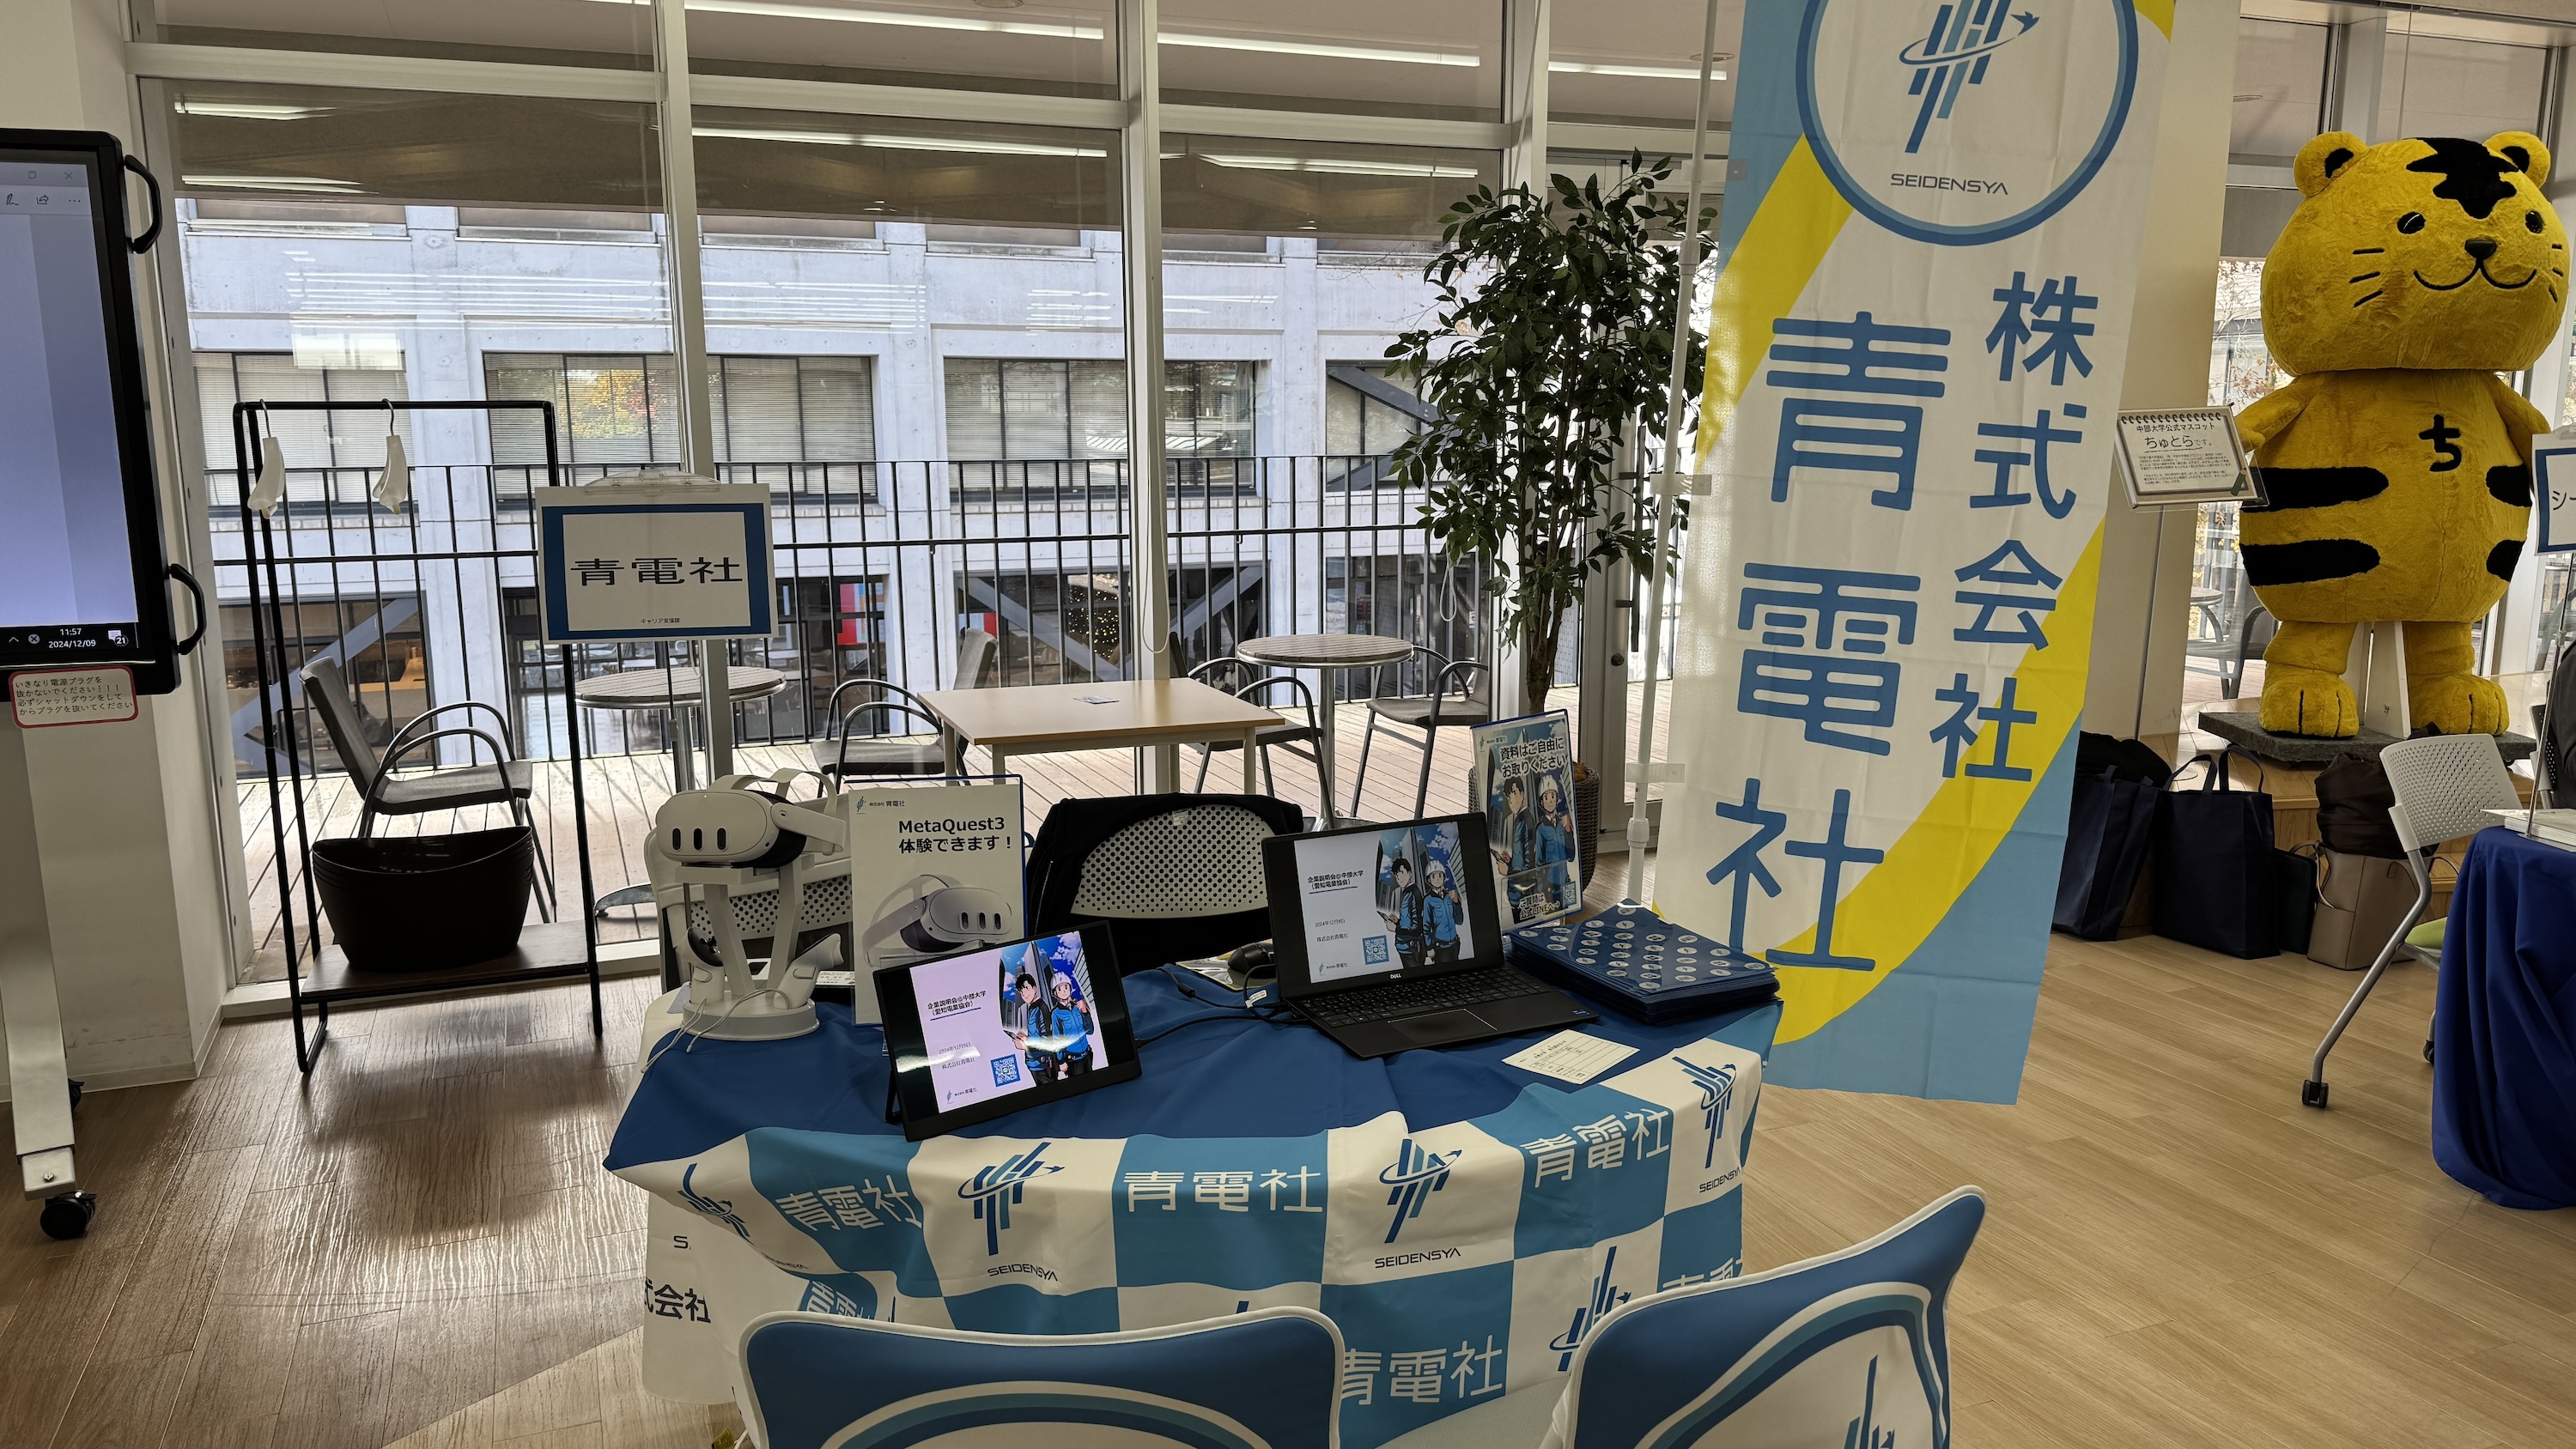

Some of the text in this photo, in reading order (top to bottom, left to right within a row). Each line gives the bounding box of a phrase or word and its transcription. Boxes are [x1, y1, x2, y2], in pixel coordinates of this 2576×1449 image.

[1890, 173, 2008, 196] SEIDENSYA
[2136, 421, 2215, 433] 中部大学公式マスコット
[2418, 414, 2462, 472] ち
[1929, 270, 2099, 782] 株式会社
[570, 556, 743, 586] 青電社
[48, 640, 96, 648] 2024/12/09
[1705, 311, 1951, 971] 青電社
[15, 676, 102, 688] いきなり電源プラグを
[18, 694, 122, 706] 必ずシャットダウンをして
[19, 702, 133, 716] からプラグを抜いてください
[1500, 737, 1564, 761] 資料はご自由に
[1502, 755, 1565, 778] お取りください
[898, 816, 1005, 834] MetaQuest3
[899, 835, 1012, 853] 体験できます！
[1520, 1108, 1670, 1188] 青電社
[1123, 1165, 1323, 1213] 青電社
[775, 1175, 922, 1231] 青電社
[1374, 1247, 1461, 1269] SEIDENSYA
[987, 1263, 1059, 1282] SEIDENSYA
[1341, 1334, 1503, 1405] 青電社
